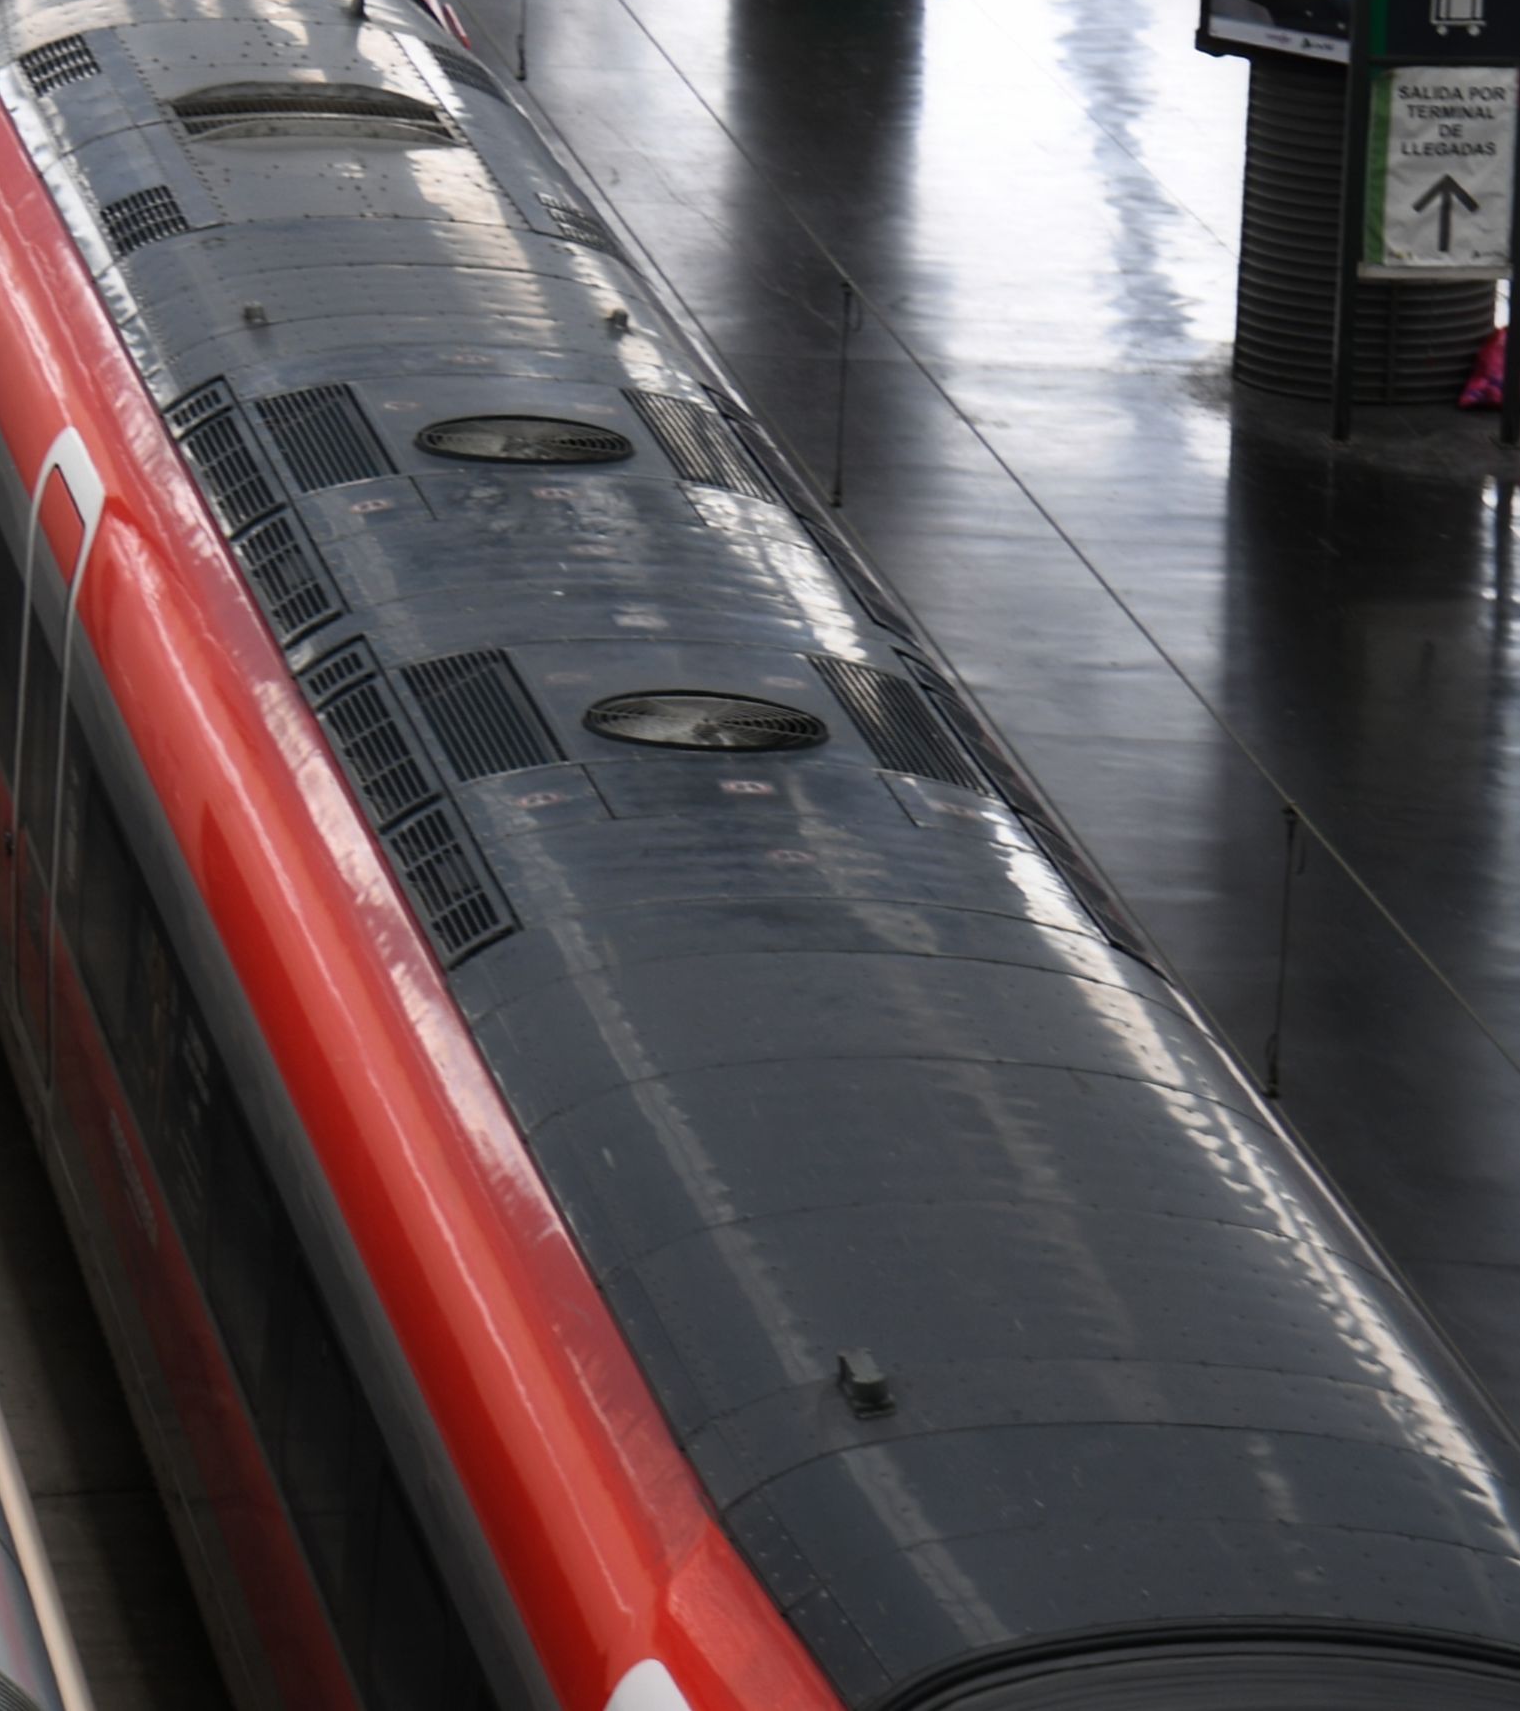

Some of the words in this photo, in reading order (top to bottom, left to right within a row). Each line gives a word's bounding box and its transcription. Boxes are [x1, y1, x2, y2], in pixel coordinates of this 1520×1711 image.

[1398, 85, 1464, 100] SALIDA
[1469, 86, 1507, 101] POR
[1406, 104, 1496, 120] TERMINAL
[1438, 123, 1464, 138] DE
[1401, 142, 1498, 157] LLEGADAS
